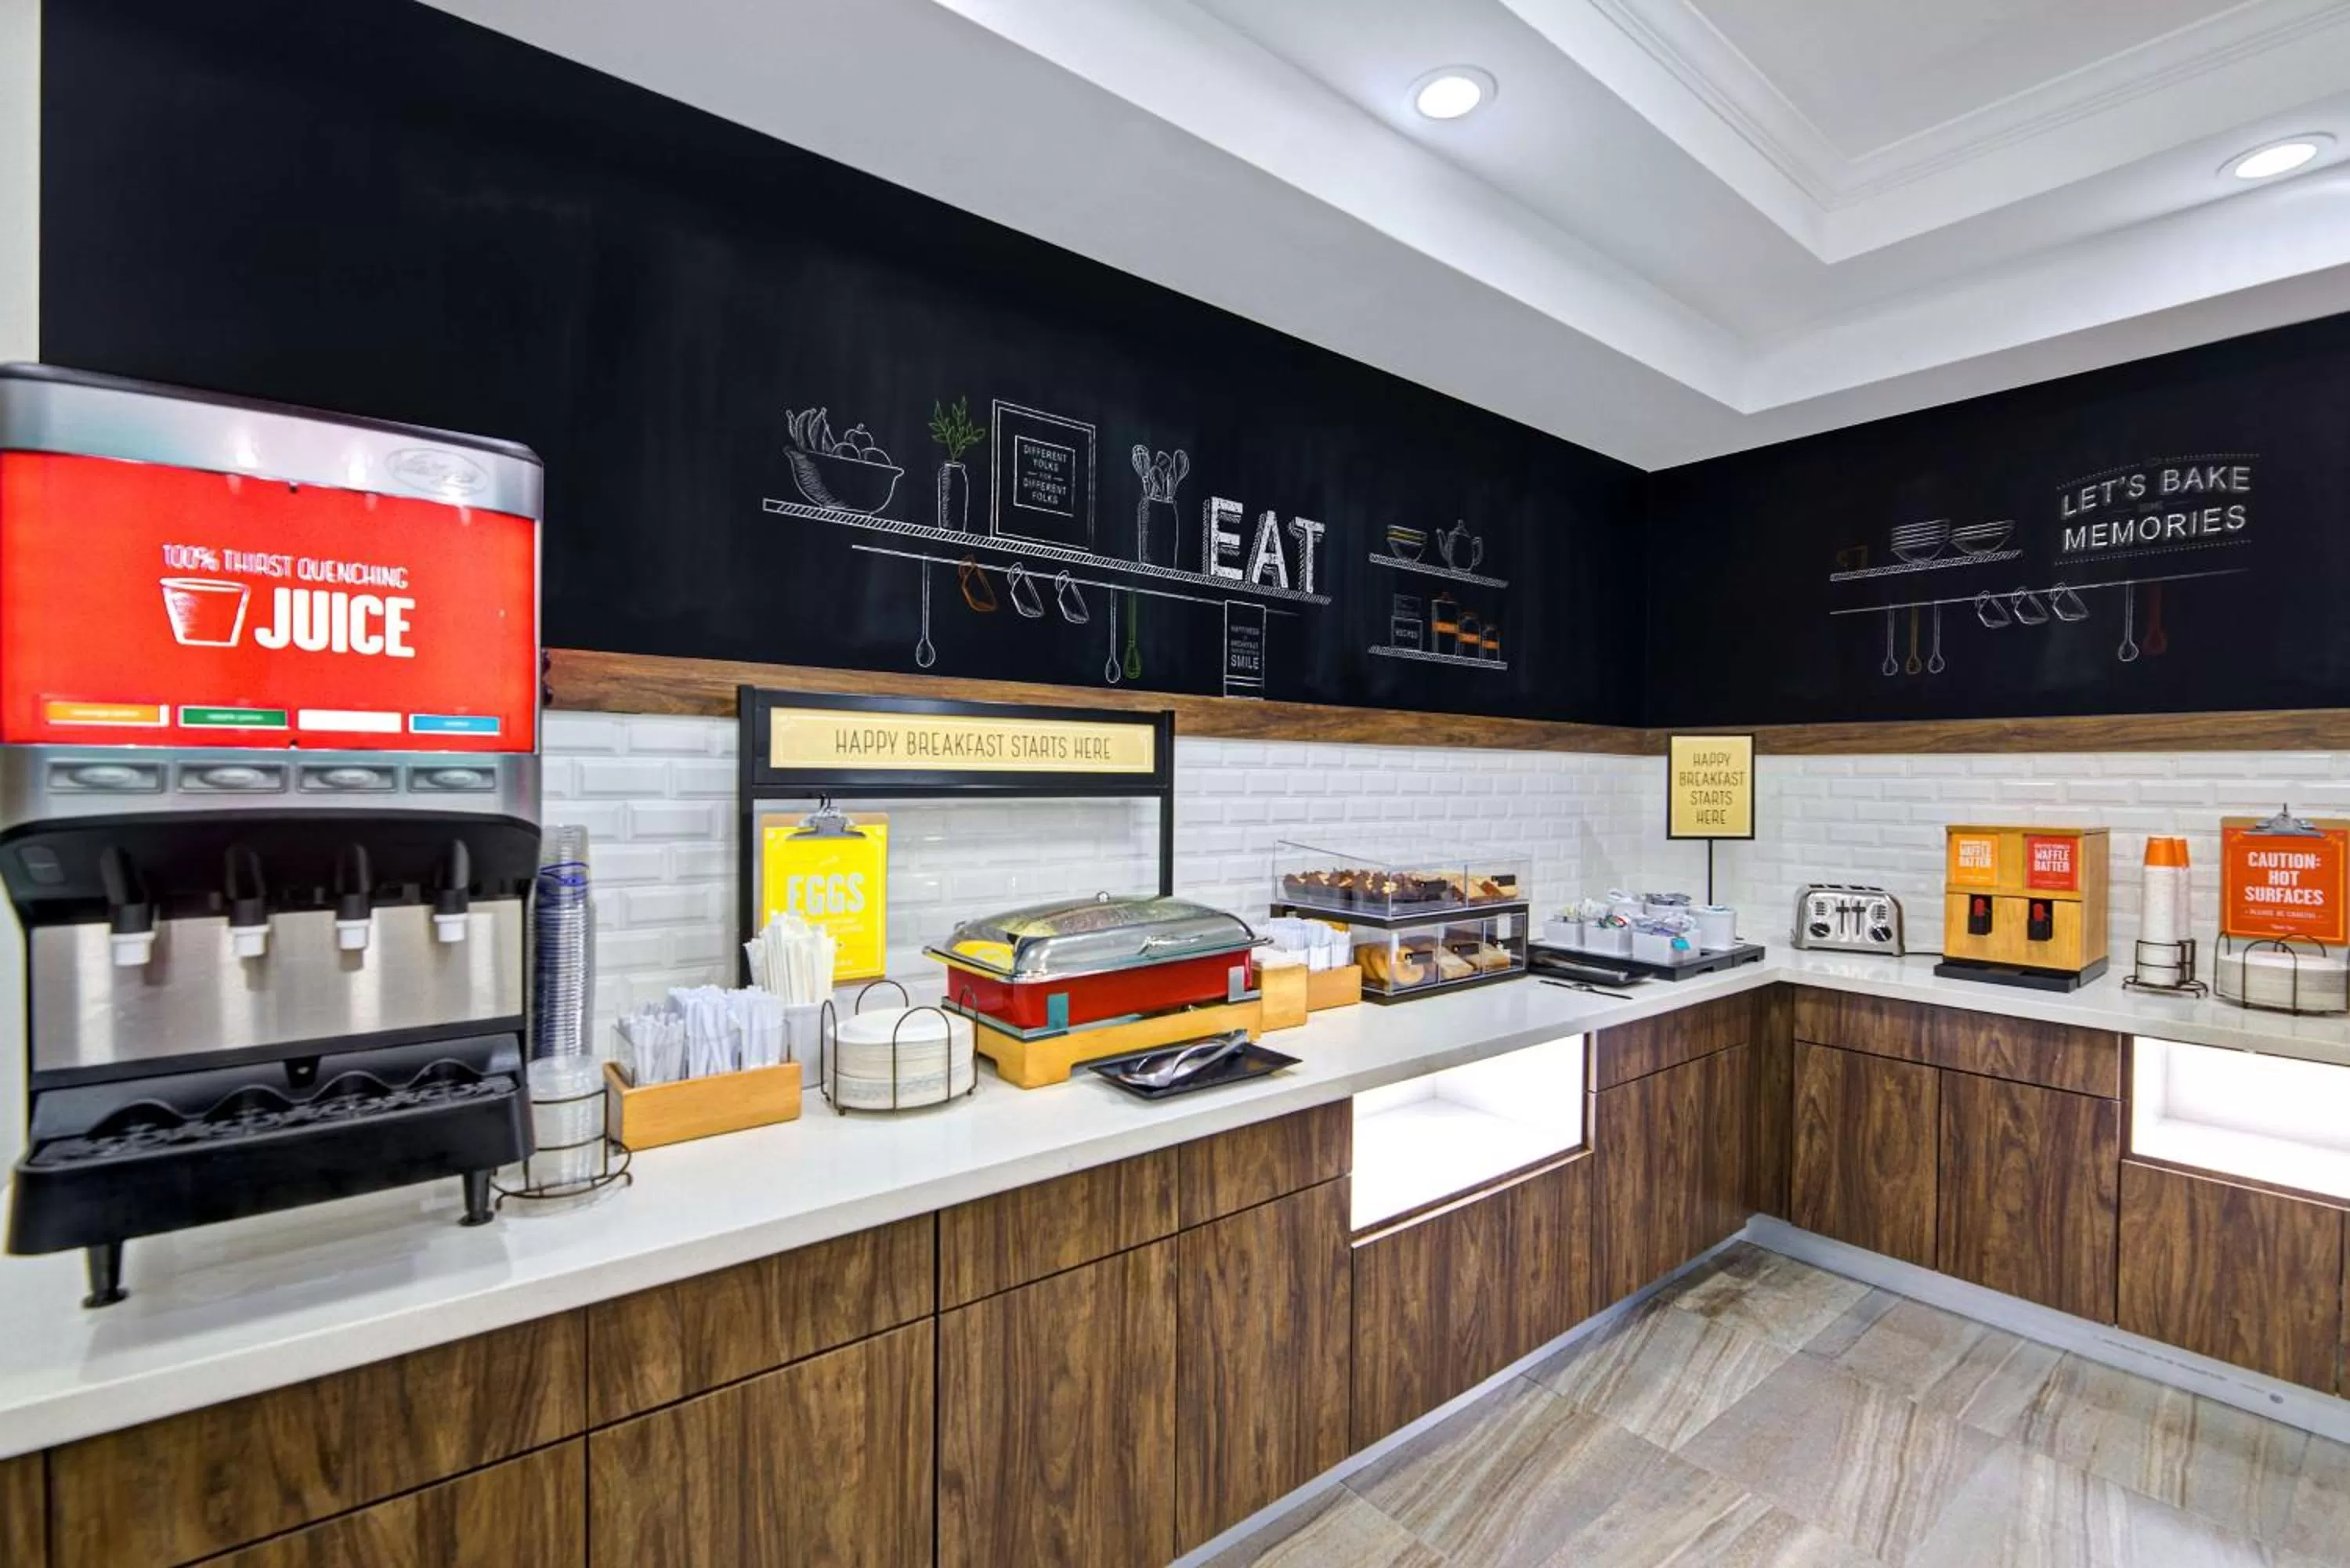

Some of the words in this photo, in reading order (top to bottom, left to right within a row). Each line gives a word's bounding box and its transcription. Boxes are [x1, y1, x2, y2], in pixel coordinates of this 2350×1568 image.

[1023, 444, 1066, 463] DIFFERENT
[1023, 476, 1066, 495] DIFFERENT
[2061, 473, 2146, 518] LET'S
[2161, 466, 2251, 493] BAKE
[1032, 490, 1058, 505] FOLKS
[2063, 504, 2246, 551] MEMORIES
[1203, 496, 1325, 594] EAT
[162, 544, 220, 573] 100%
[222, 549, 293, 578] THIRST
[297, 557, 409, 589] QUENCHING
[254, 587, 416, 658] JUICE
[1231, 654, 1260, 670] SMILE
[835, 729, 898, 756] HAPPY
[906, 731, 1005, 758] BREAKFAST
[1010, 735, 1068, 759] STARTS
[1074, 736, 1112, 760] HERE
[1693, 752, 1730, 767] HAPPY
[1679, 771, 1746, 787] BREAKFAST
[1690, 790, 1733, 806] STARTS
[1696, 809, 1726, 825] HERE
[2034, 848, 2070, 862] WAFFLE
[2247, 851, 2321, 869] CAUTION:
[2034, 860, 2070, 873] BATTER
[2268, 869, 2300, 887] HOT
[787, 871, 866, 916] EGGS
[2244, 886, 2324, 905] SURFACES
